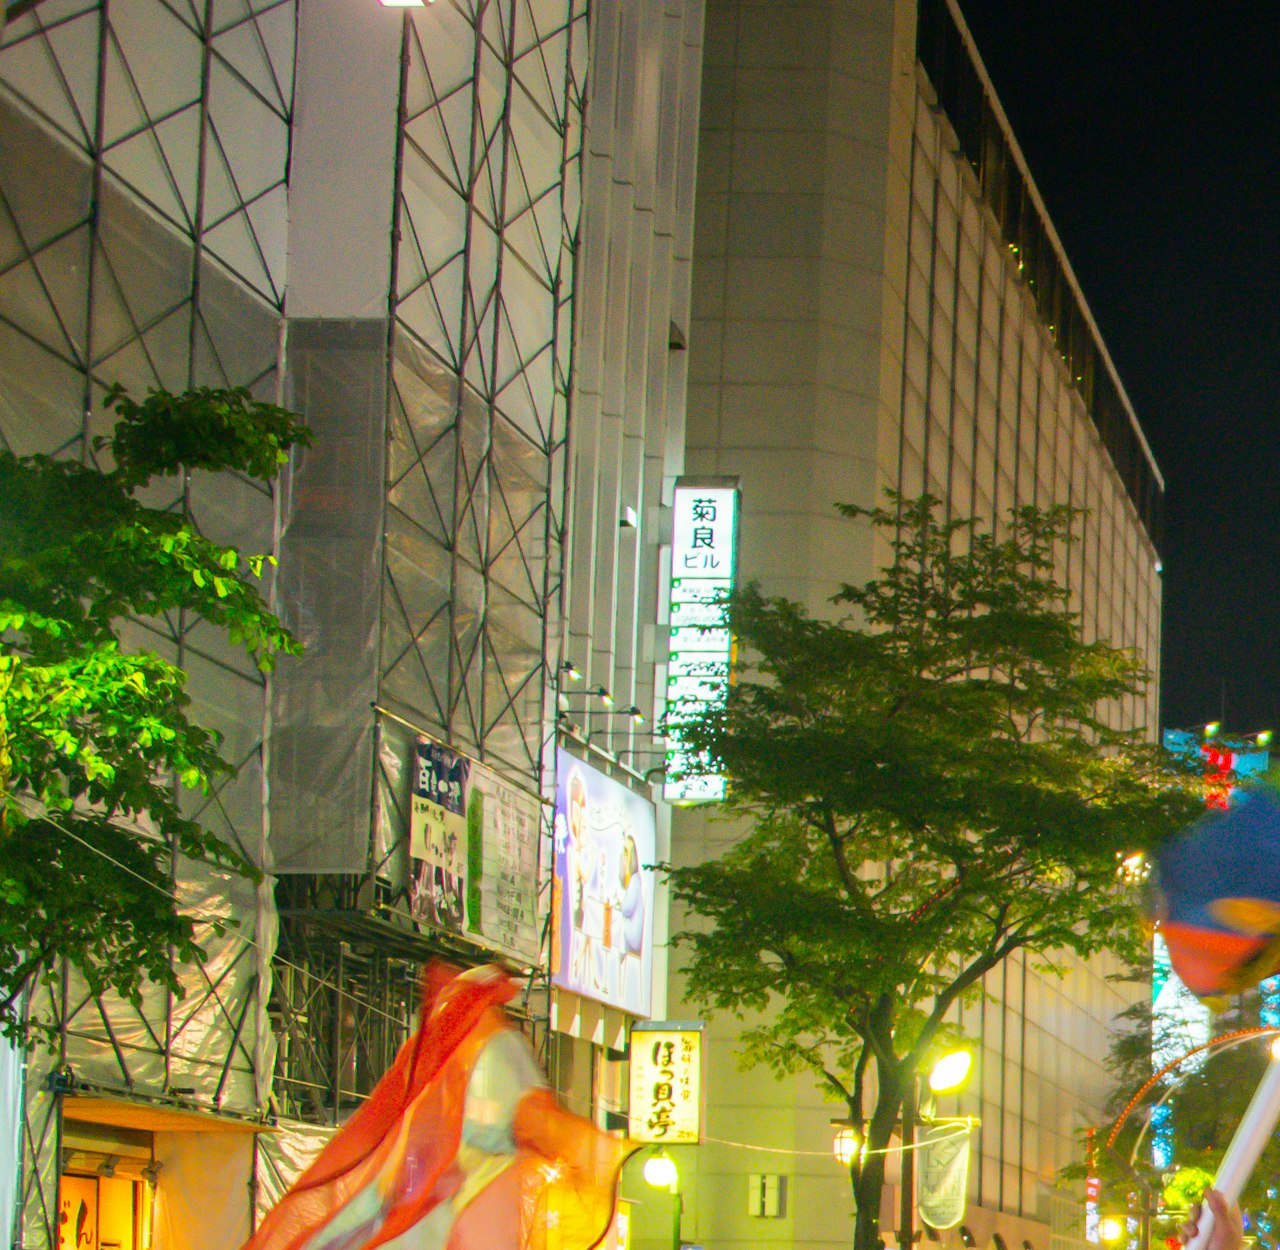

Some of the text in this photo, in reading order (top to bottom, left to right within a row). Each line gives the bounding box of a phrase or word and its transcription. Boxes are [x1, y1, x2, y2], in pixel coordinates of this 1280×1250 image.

[691, 498, 717, 549] 菊良
[684, 553, 720, 569] ビル
[646, 1040, 676, 1138] ほっ貝亭
